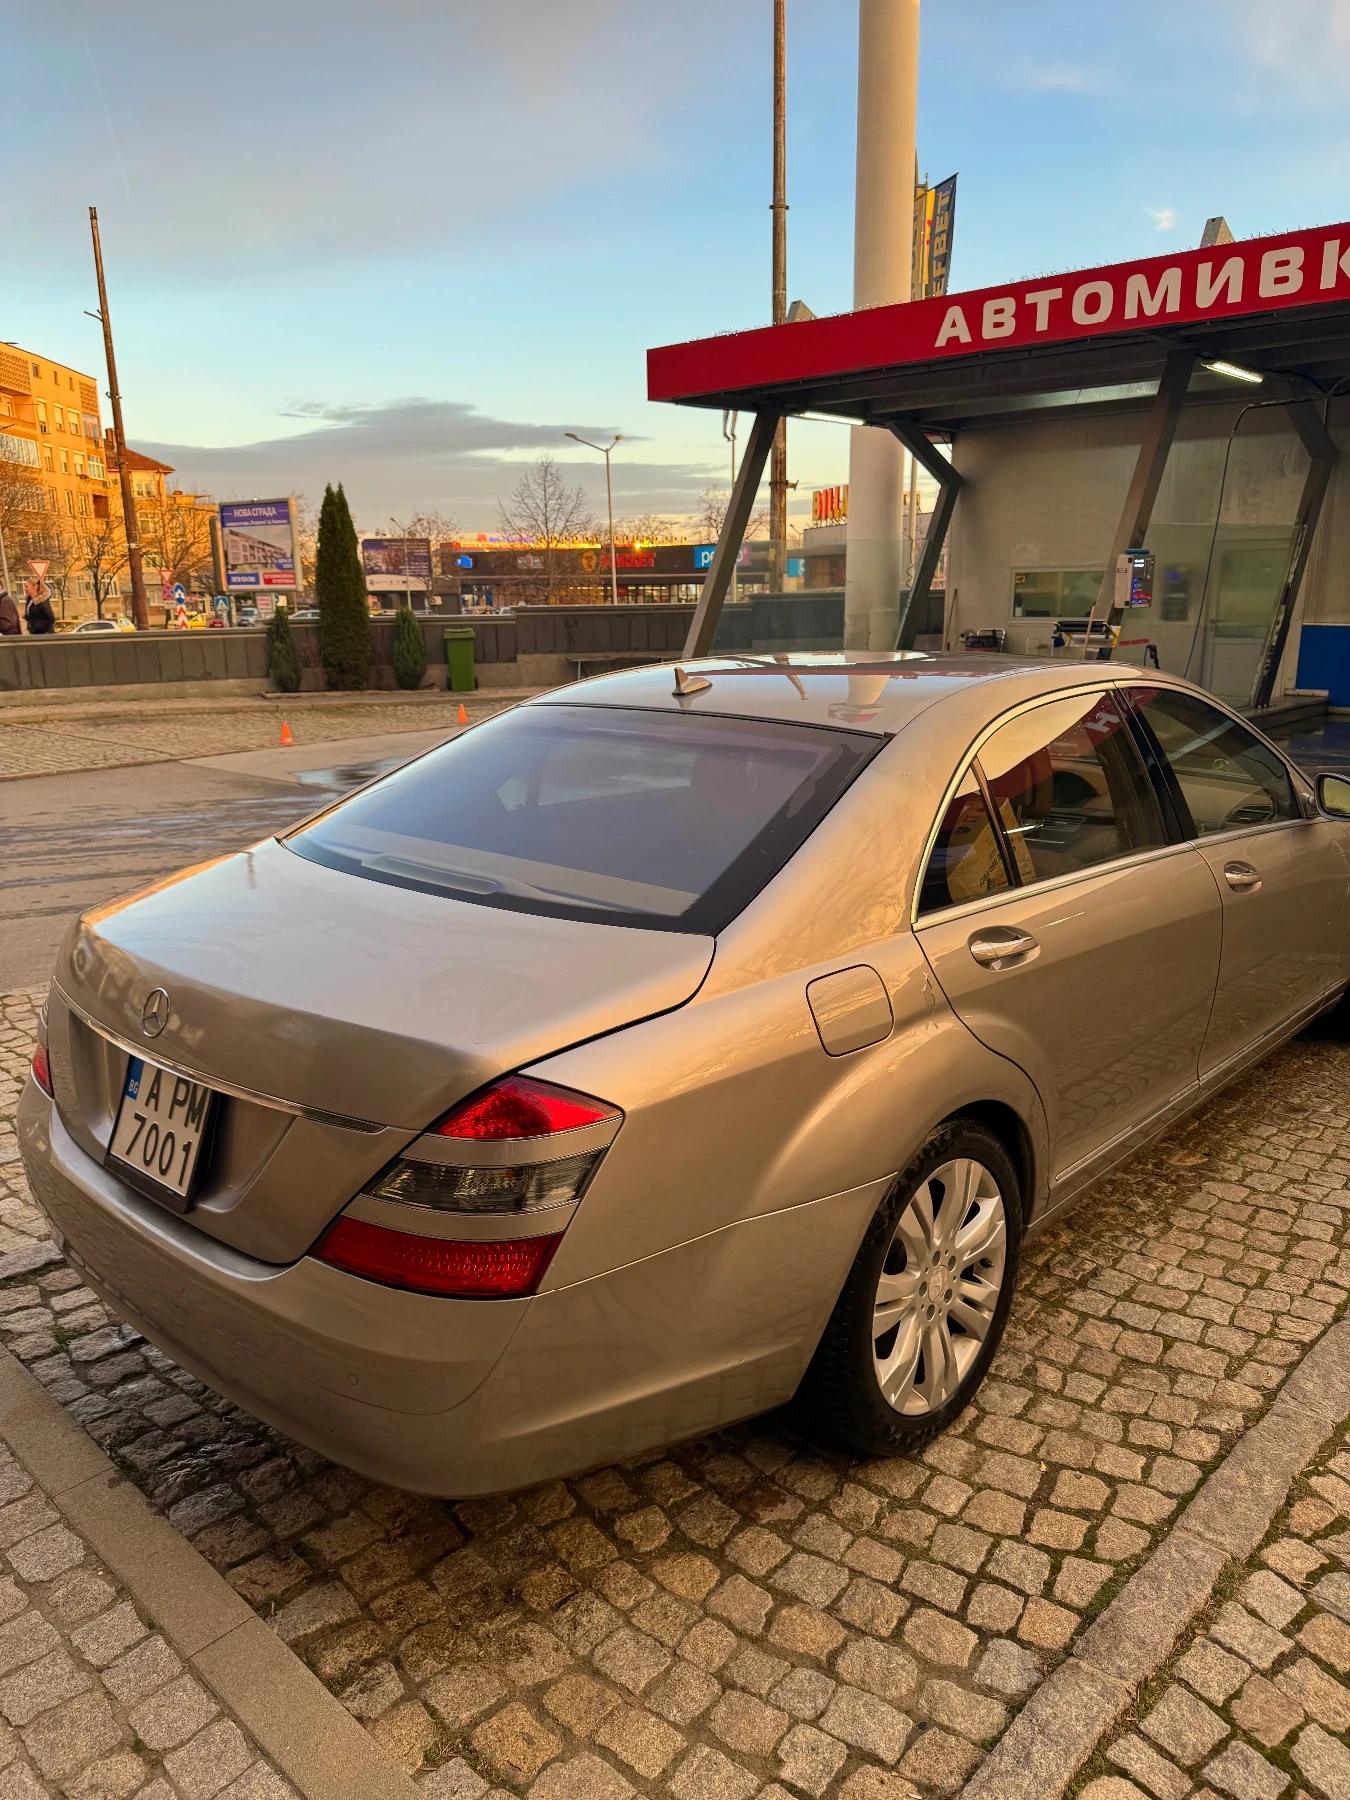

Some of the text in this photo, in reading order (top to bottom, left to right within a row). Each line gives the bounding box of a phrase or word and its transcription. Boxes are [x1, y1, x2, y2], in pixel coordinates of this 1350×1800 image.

[233, 506, 277, 518] НОВА СГРАДА
[128, 1079, 139, 1094] BG
[145, 1068, 209, 1133] A PM
[125, 1110, 193, 1187] 7001
